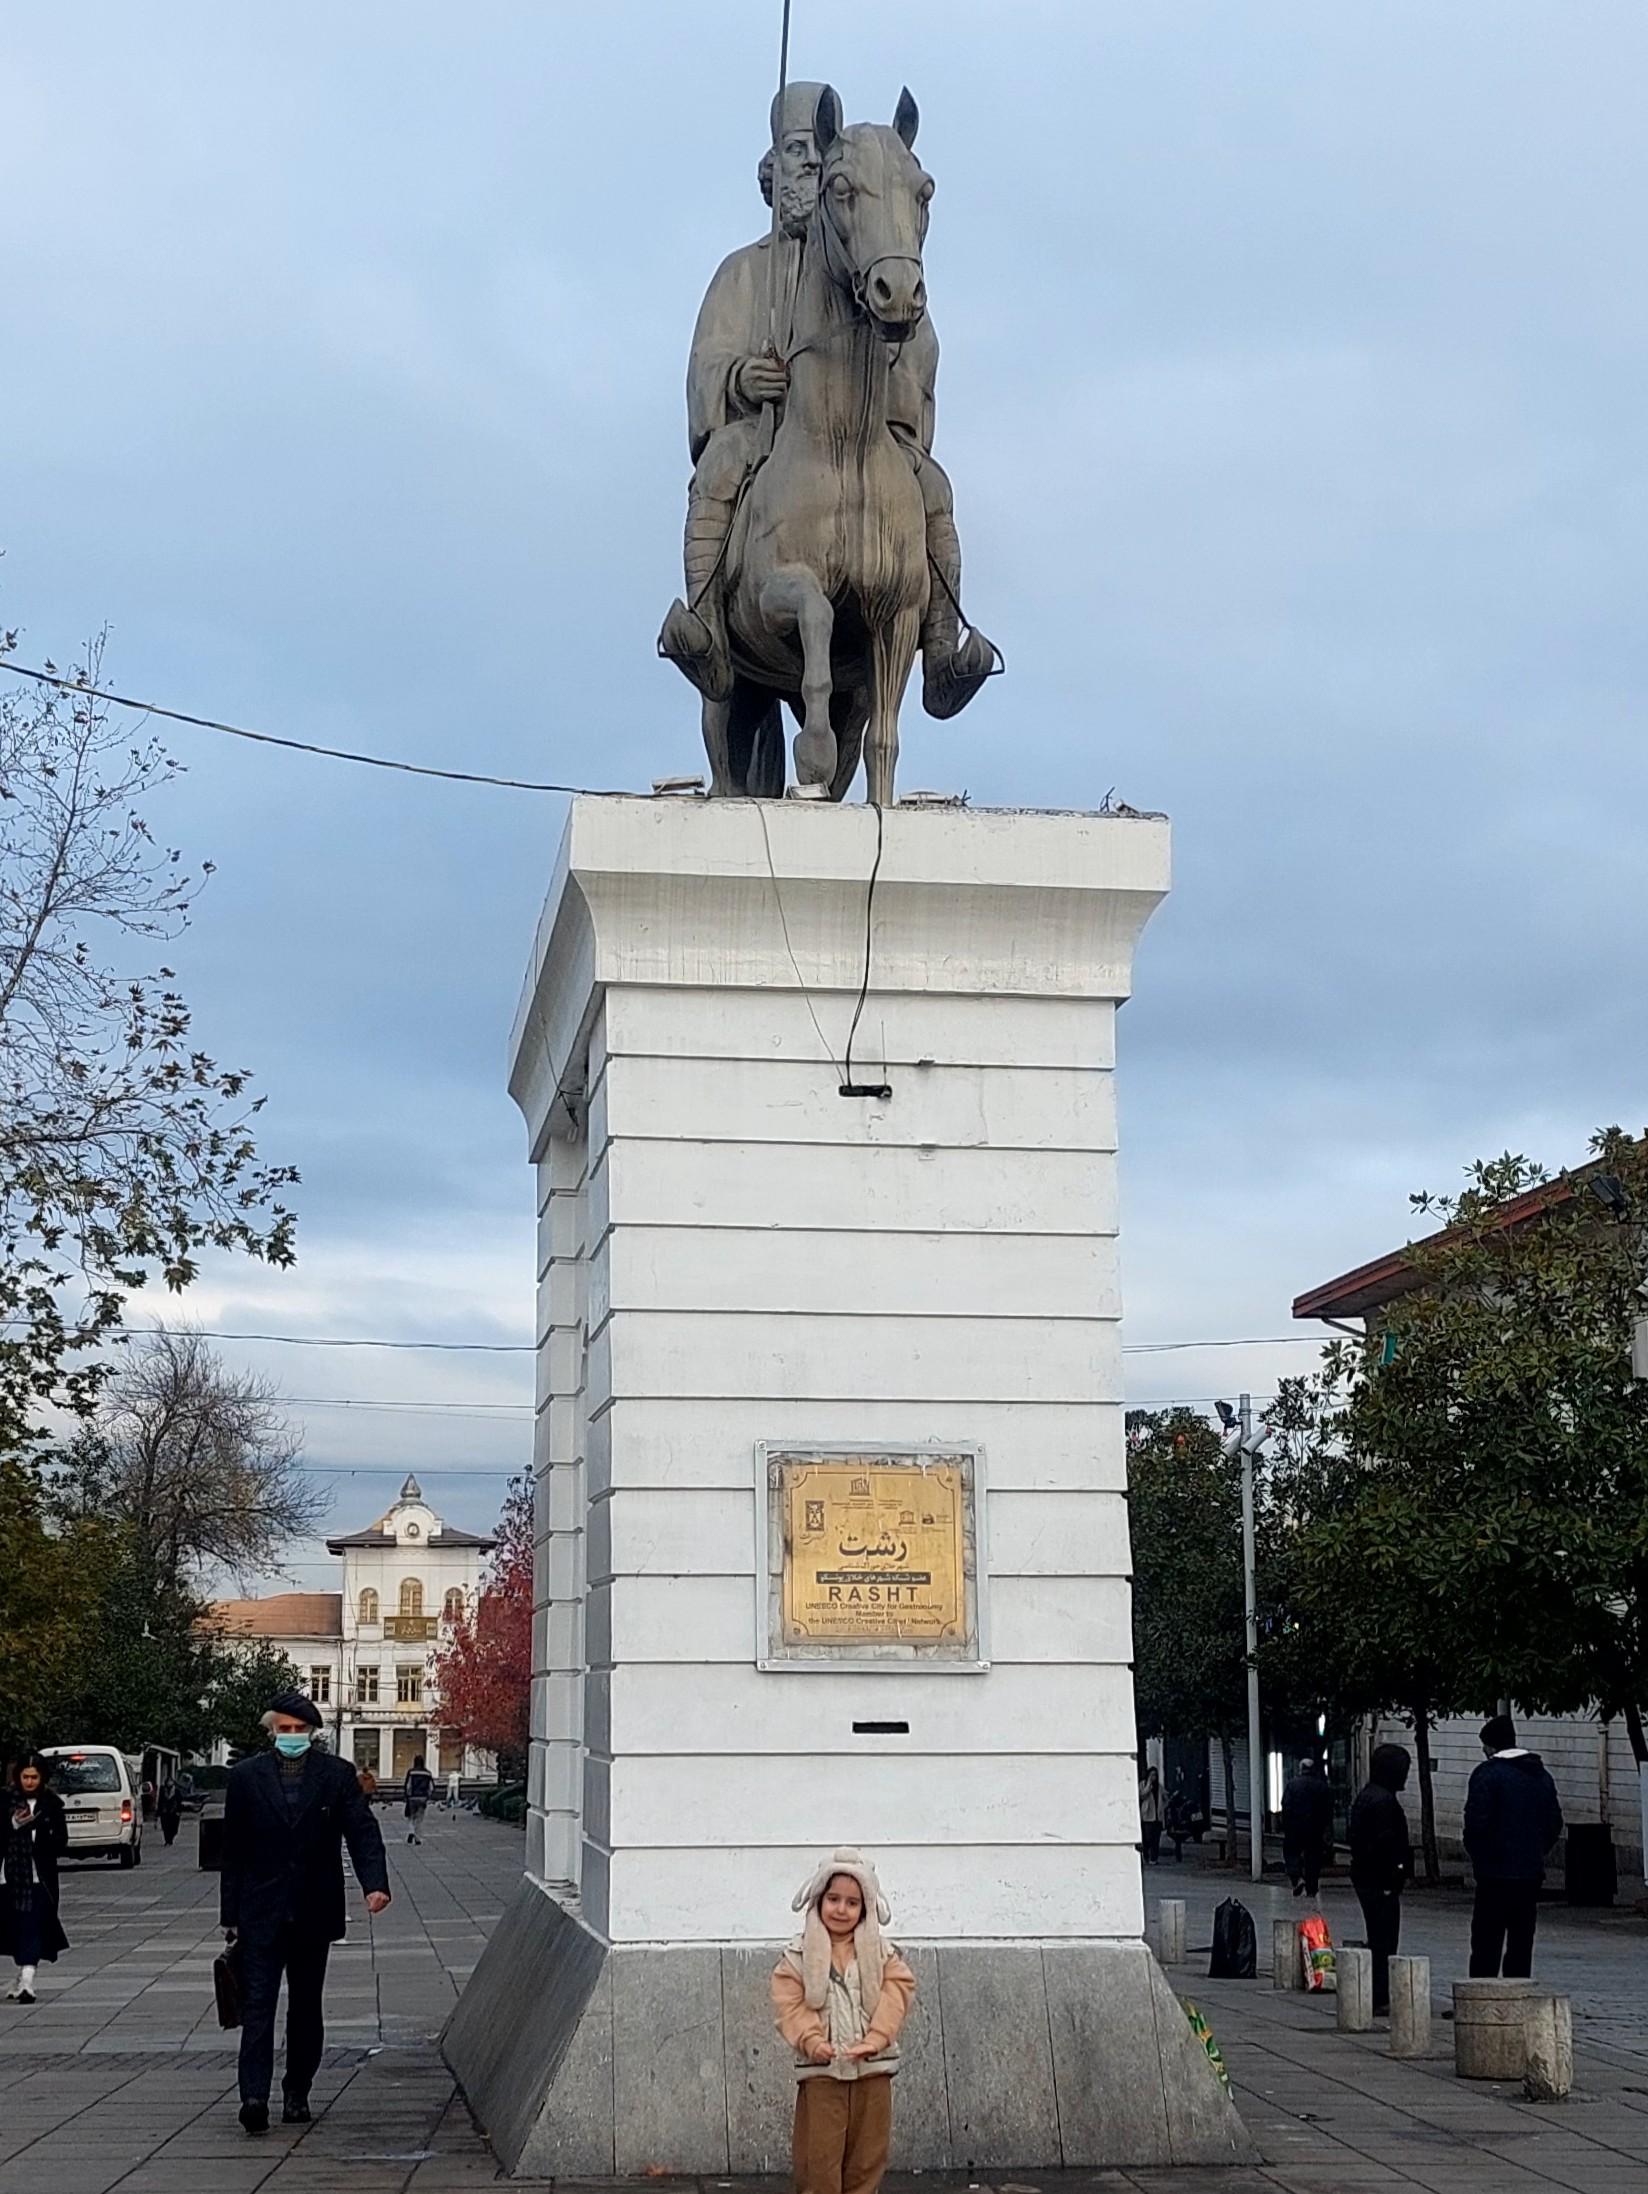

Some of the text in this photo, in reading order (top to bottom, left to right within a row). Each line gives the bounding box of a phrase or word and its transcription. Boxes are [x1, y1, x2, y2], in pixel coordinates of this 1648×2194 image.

[838, 1532, 907, 1561] رشت
[828, 1586, 918, 1602] RASHT
[805, 1602, 838, 1610] UNESCO
[839, 1602, 869, 1610] Creative
[870, 1603, 885, 1611] City
[808, 1617, 820, 1625] the
[821, 1617, 855, 1625] UNESCO
[855, 1617, 885, 1625] Creative
